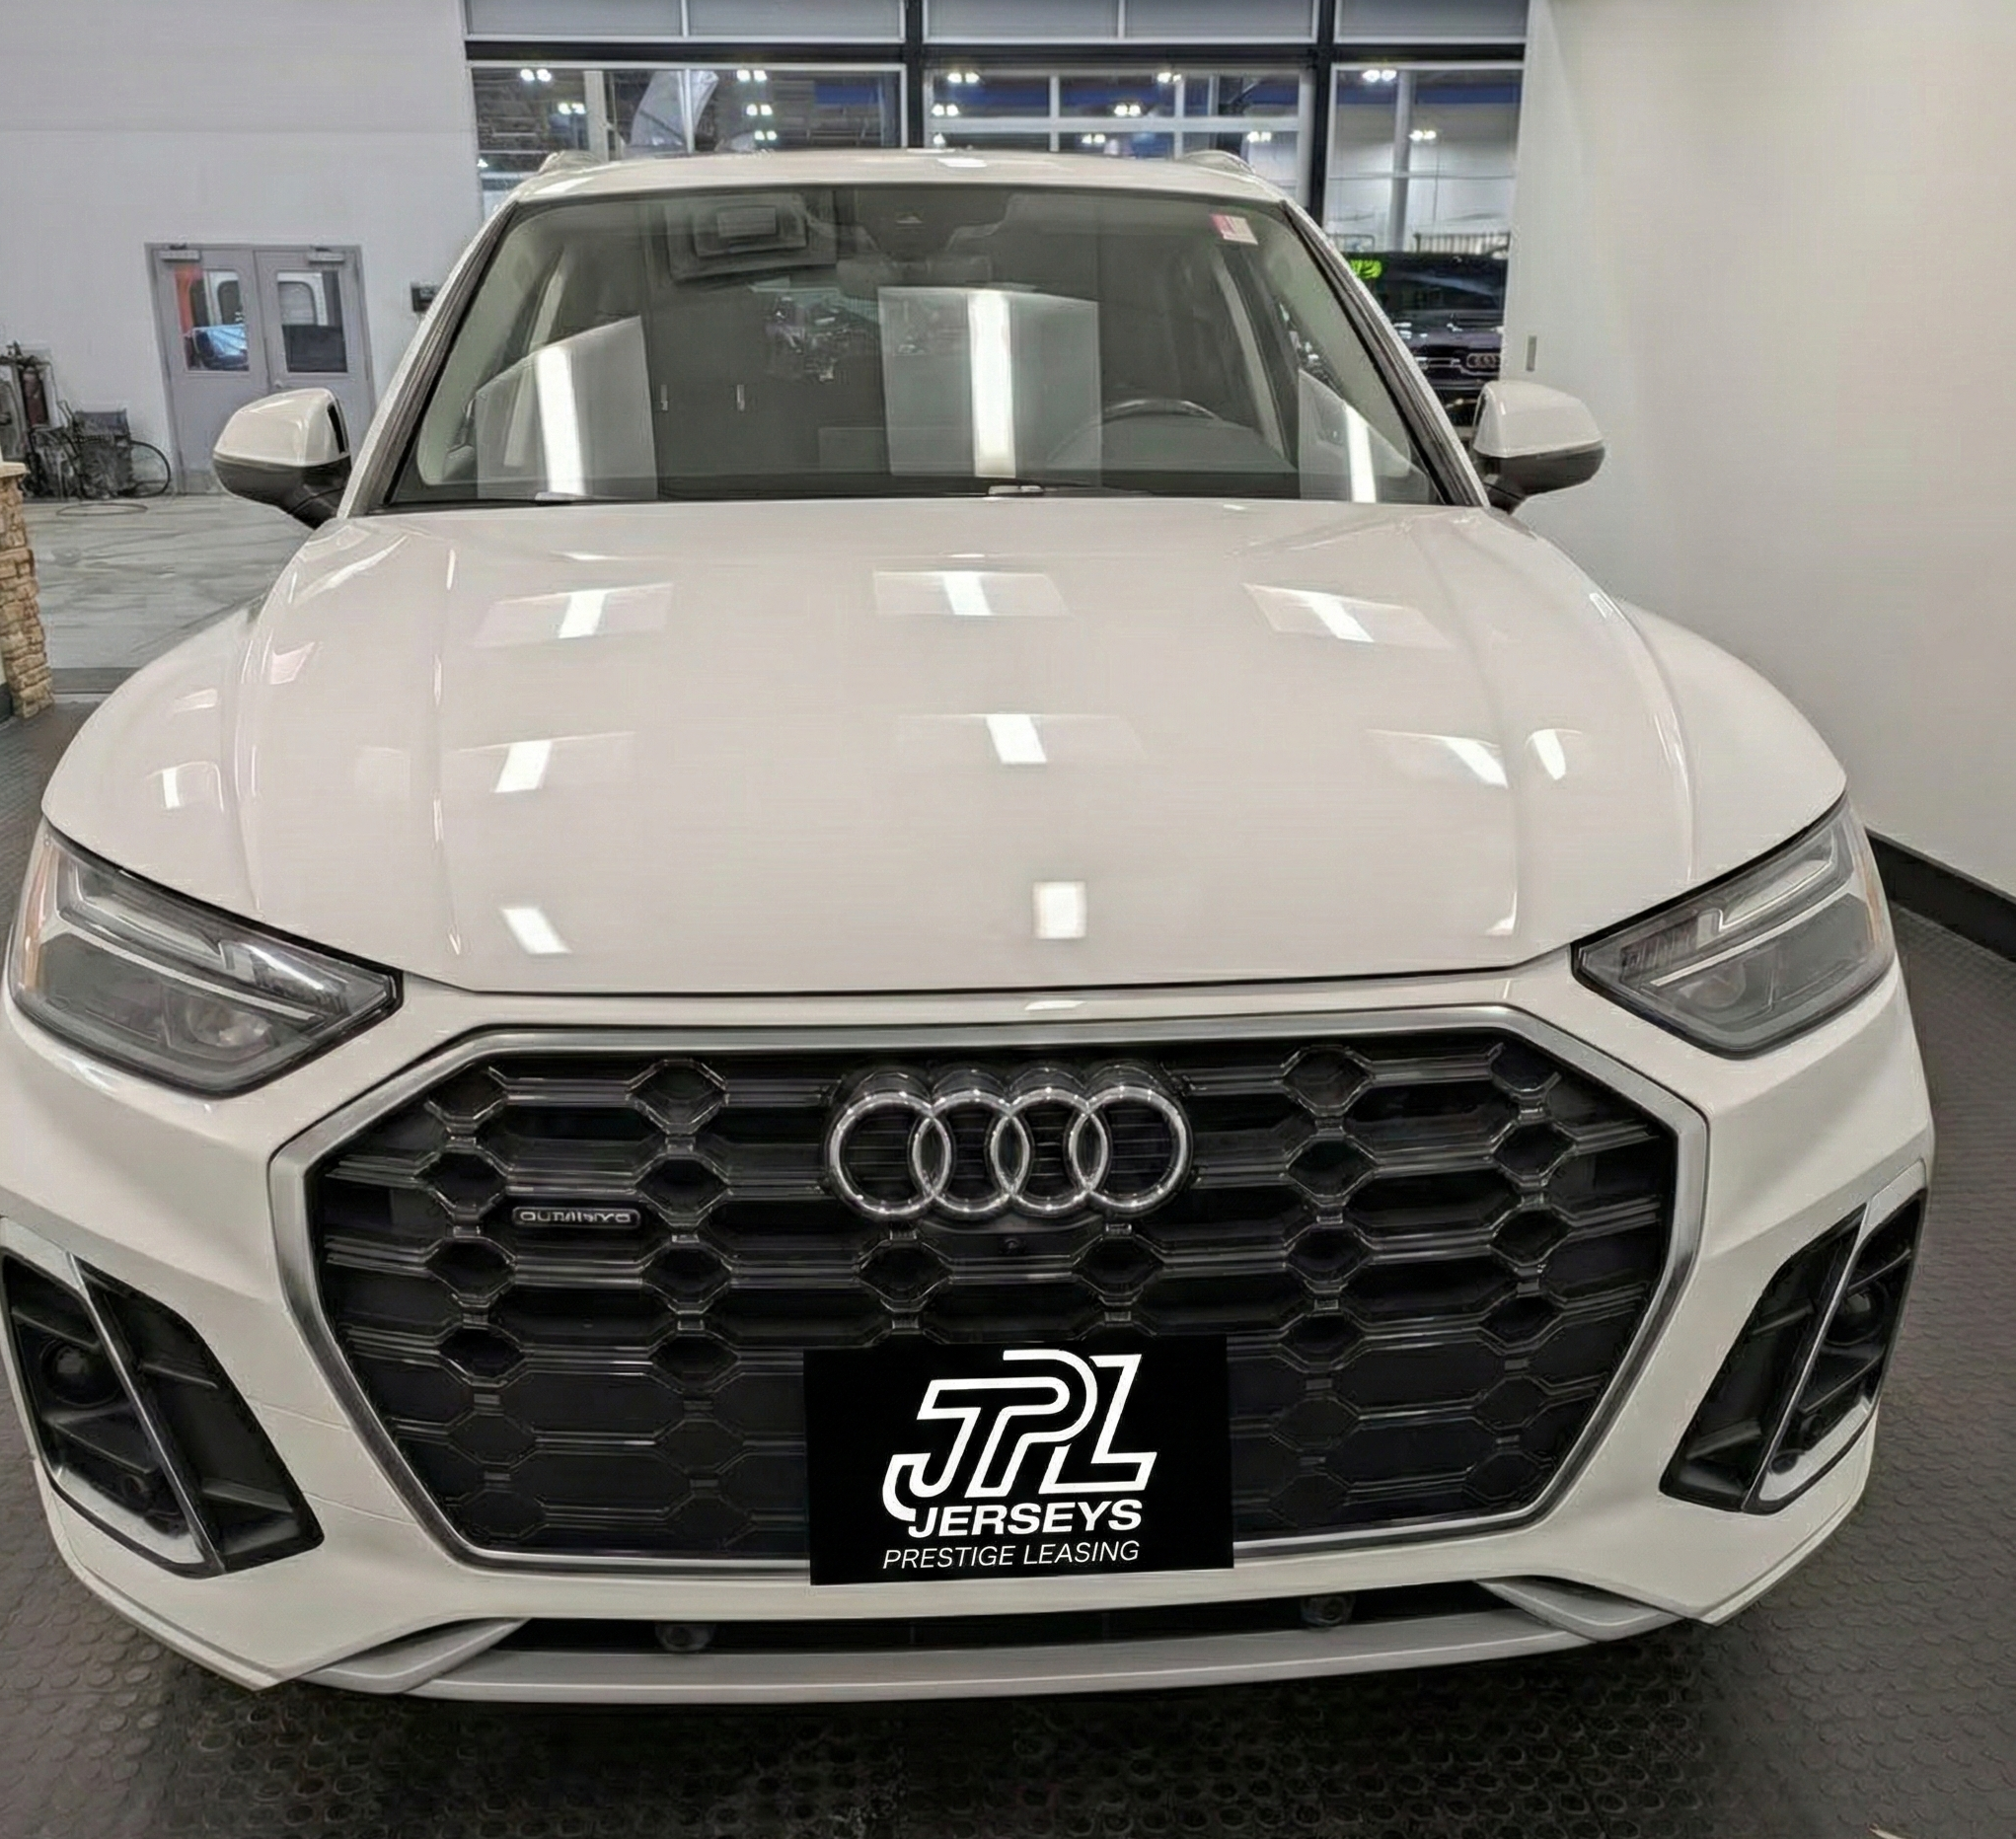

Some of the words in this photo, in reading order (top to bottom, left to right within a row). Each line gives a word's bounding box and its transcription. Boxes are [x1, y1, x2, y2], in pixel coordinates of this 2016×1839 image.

[882, 1349, 1157, 1522] JPL
[908, 1499, 1143, 1539] JERSEYS
[882, 1544, 1016, 1570] PRESTIGE
[1023, 1539, 1140, 1565] LEASING
